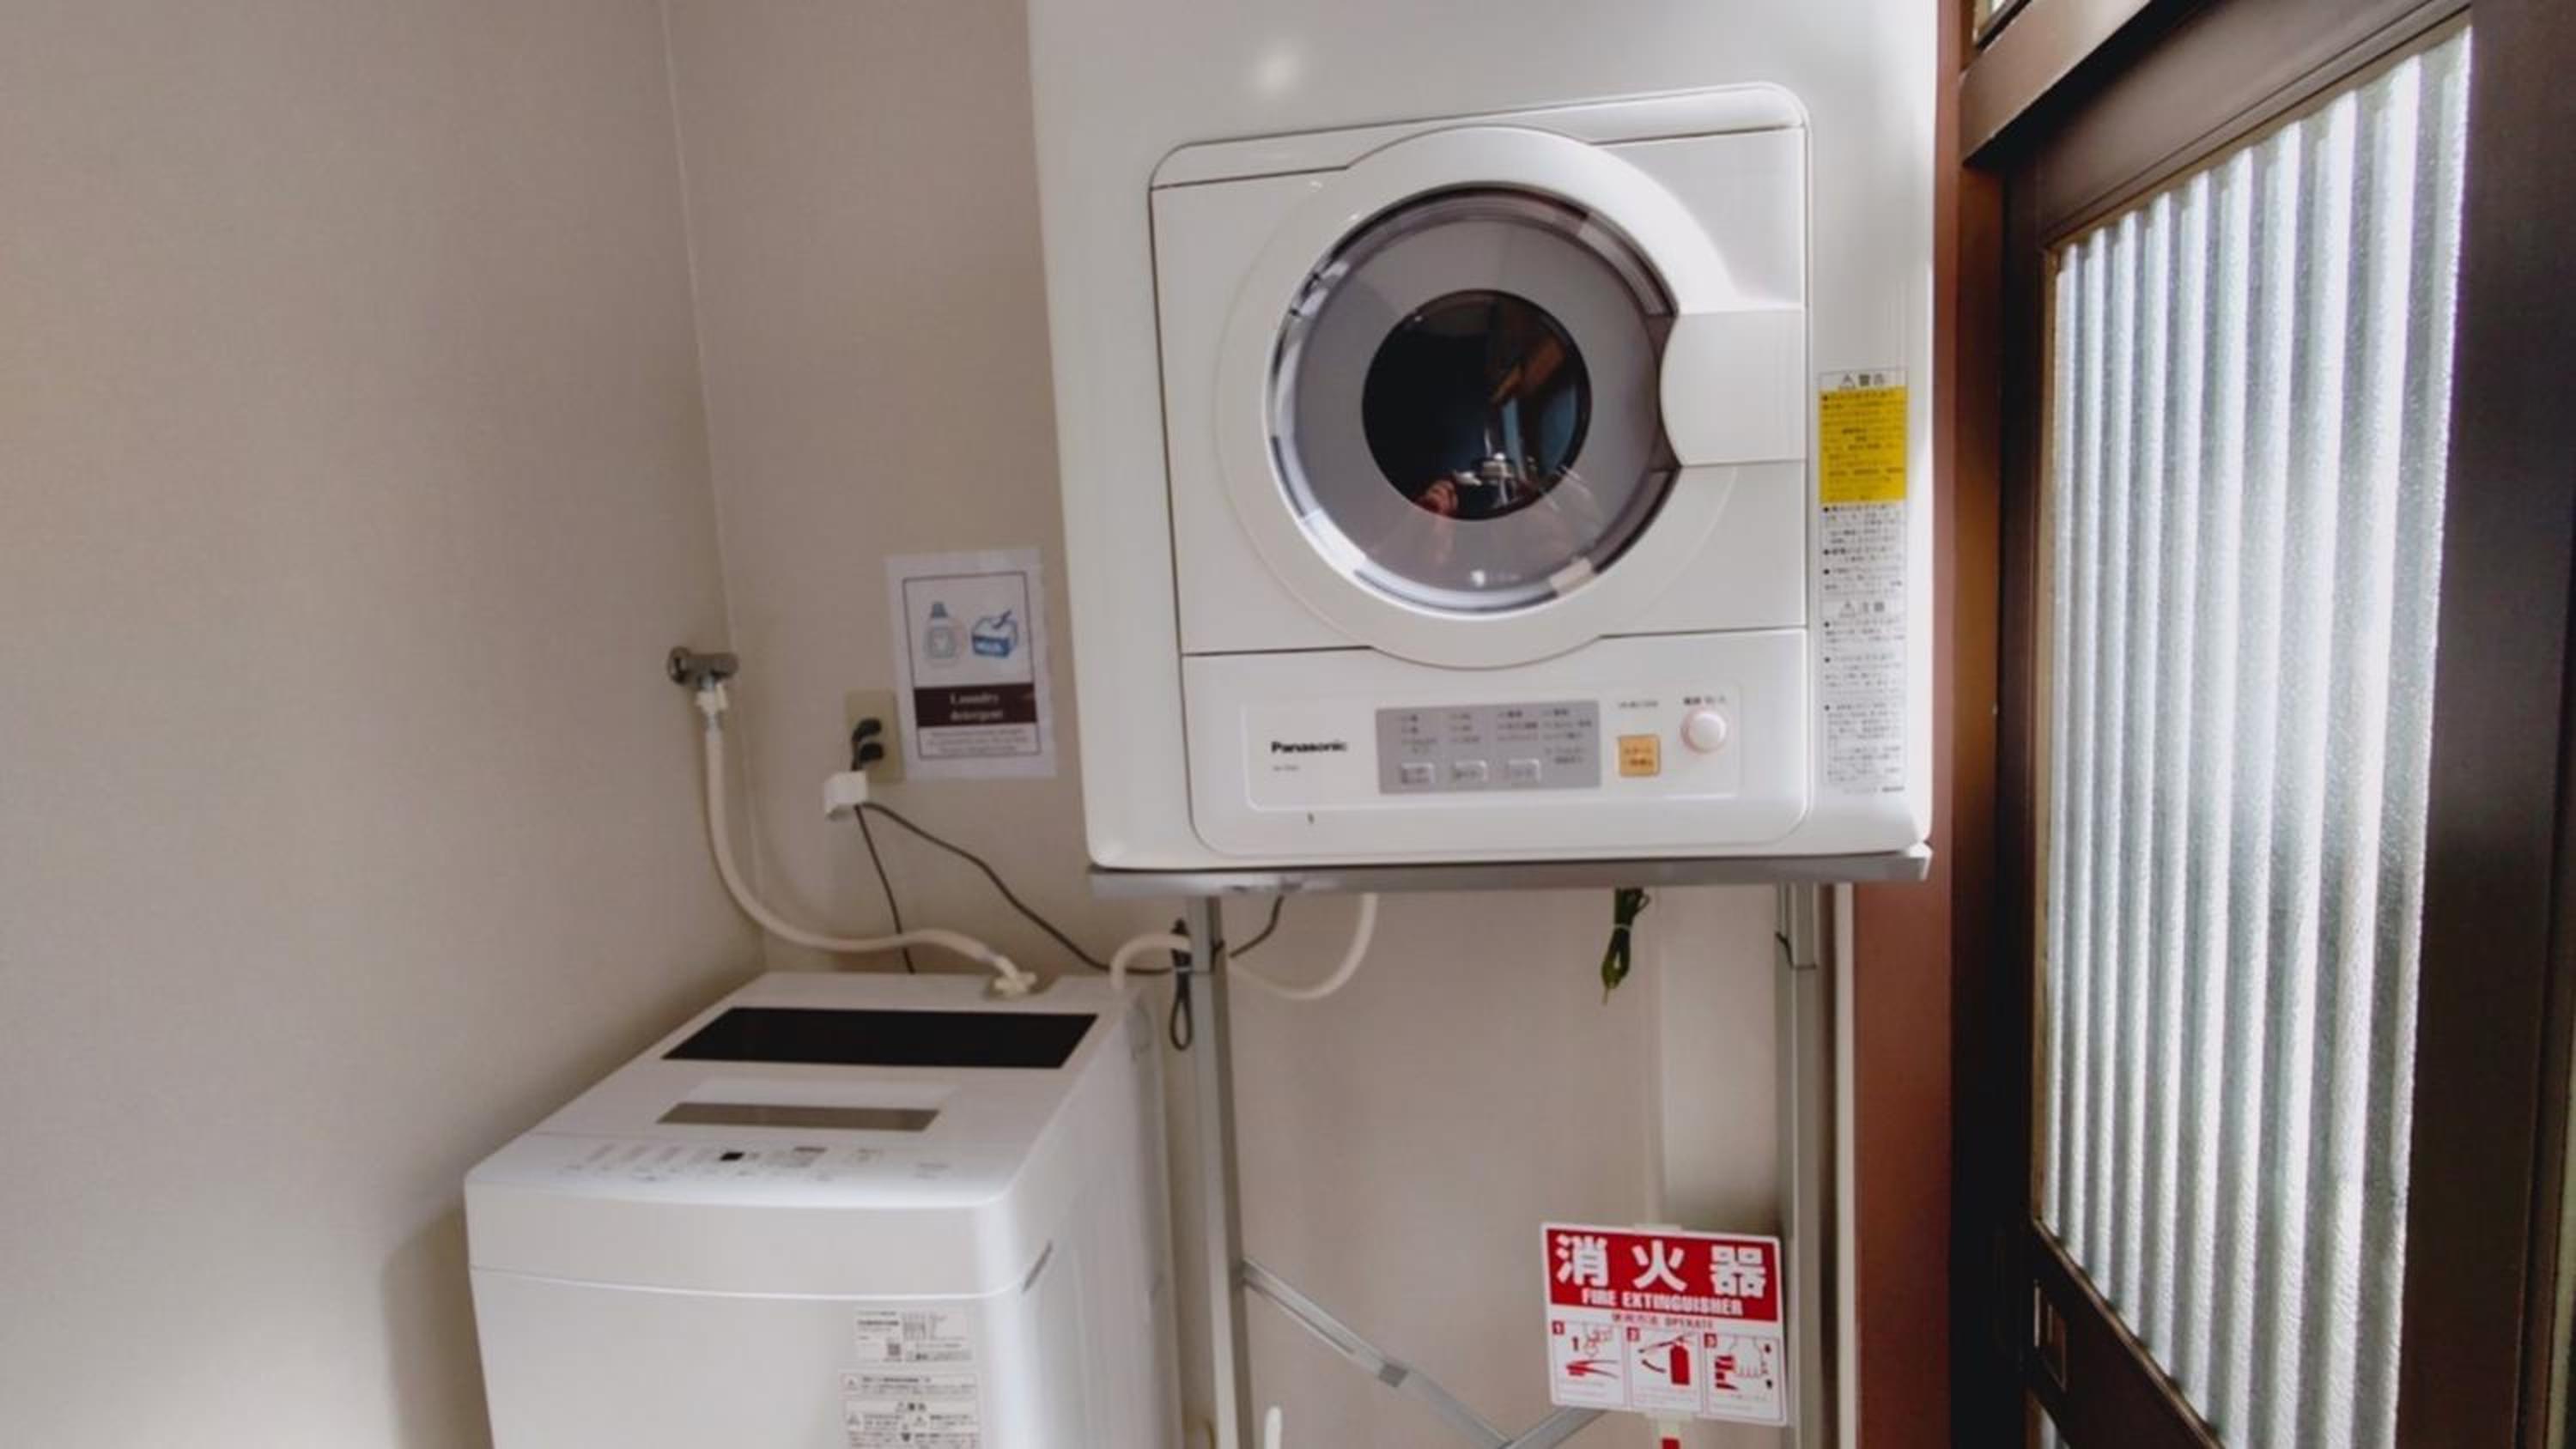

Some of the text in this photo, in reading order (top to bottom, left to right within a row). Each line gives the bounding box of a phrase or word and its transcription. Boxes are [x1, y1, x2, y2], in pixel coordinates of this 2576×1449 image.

[949, 692, 999, 706] Laundry
[1271, 739, 1348, 754] Panasonic
[1555, 1234, 1766, 1298] 消火器
[1582, 1288, 1744, 1316] FIRE EXTINGUISHER
